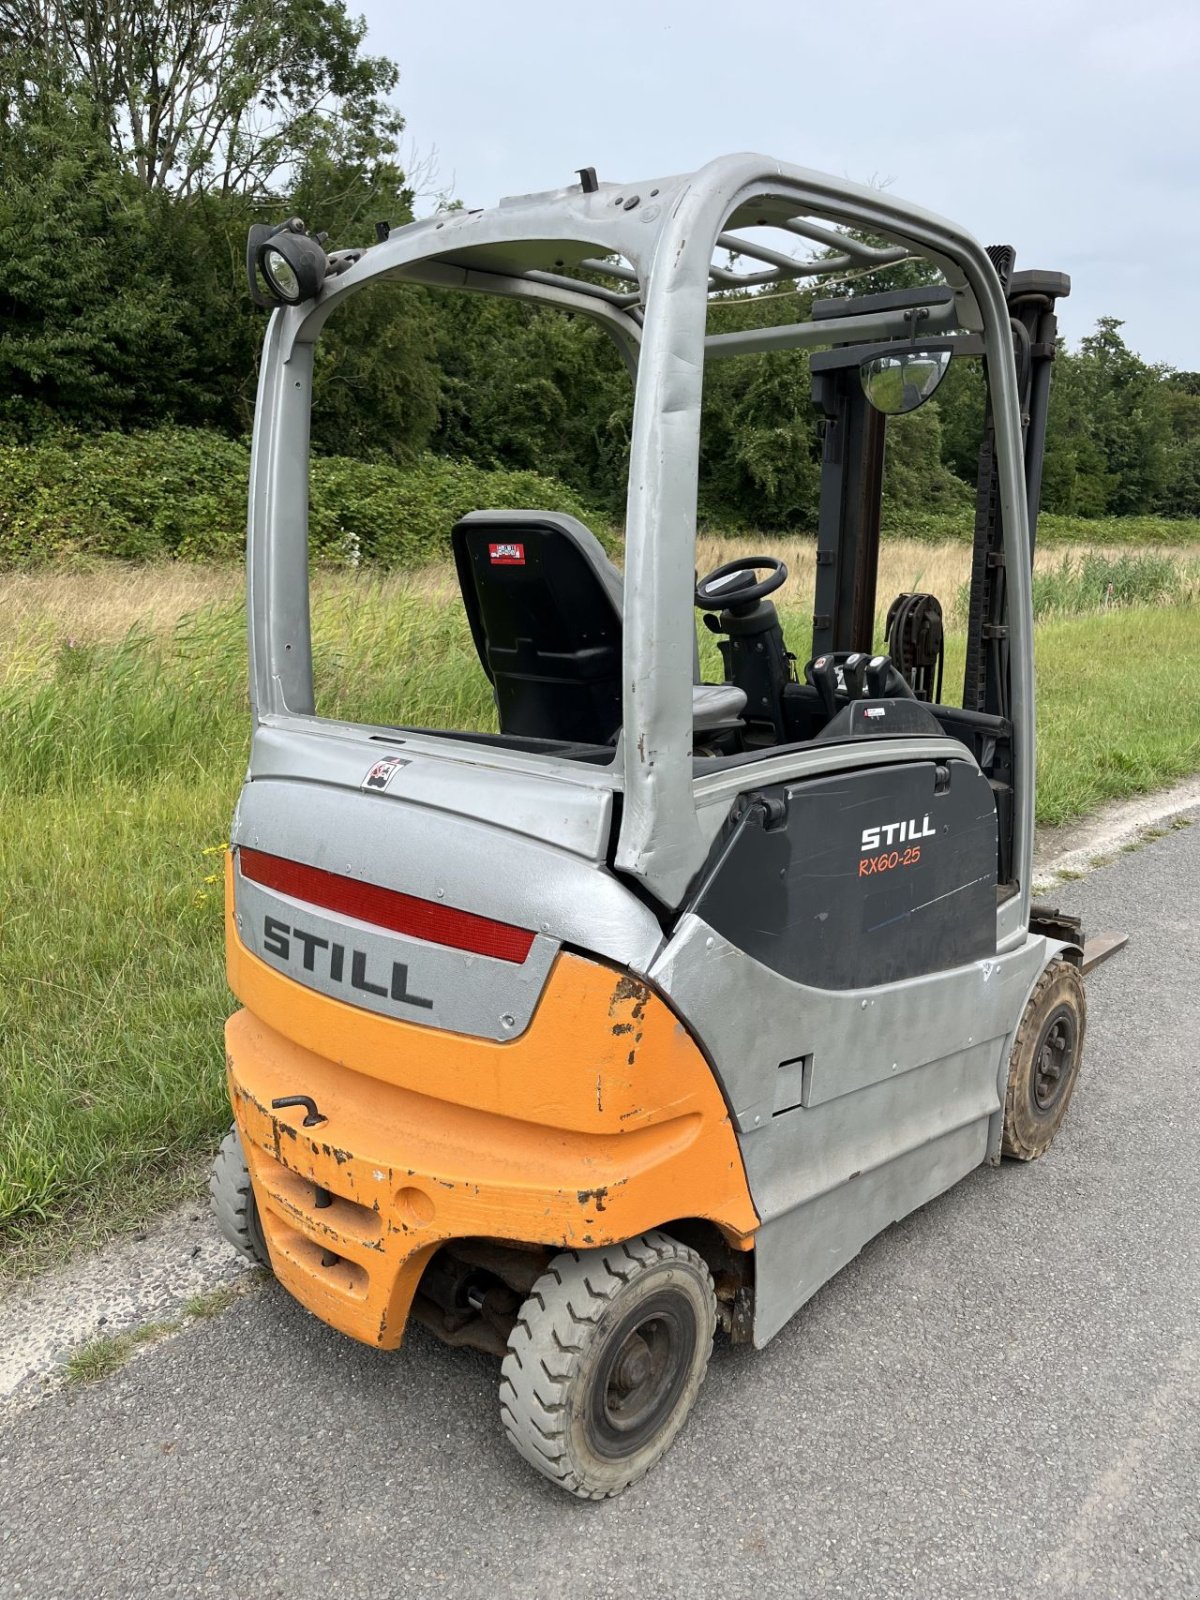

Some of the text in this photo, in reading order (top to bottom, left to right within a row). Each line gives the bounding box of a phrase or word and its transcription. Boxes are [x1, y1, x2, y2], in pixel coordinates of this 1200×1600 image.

[861, 816, 936, 851] STILL
[859, 846, 921, 877] RX60-25
[263, 914, 433, 1010] STILL
